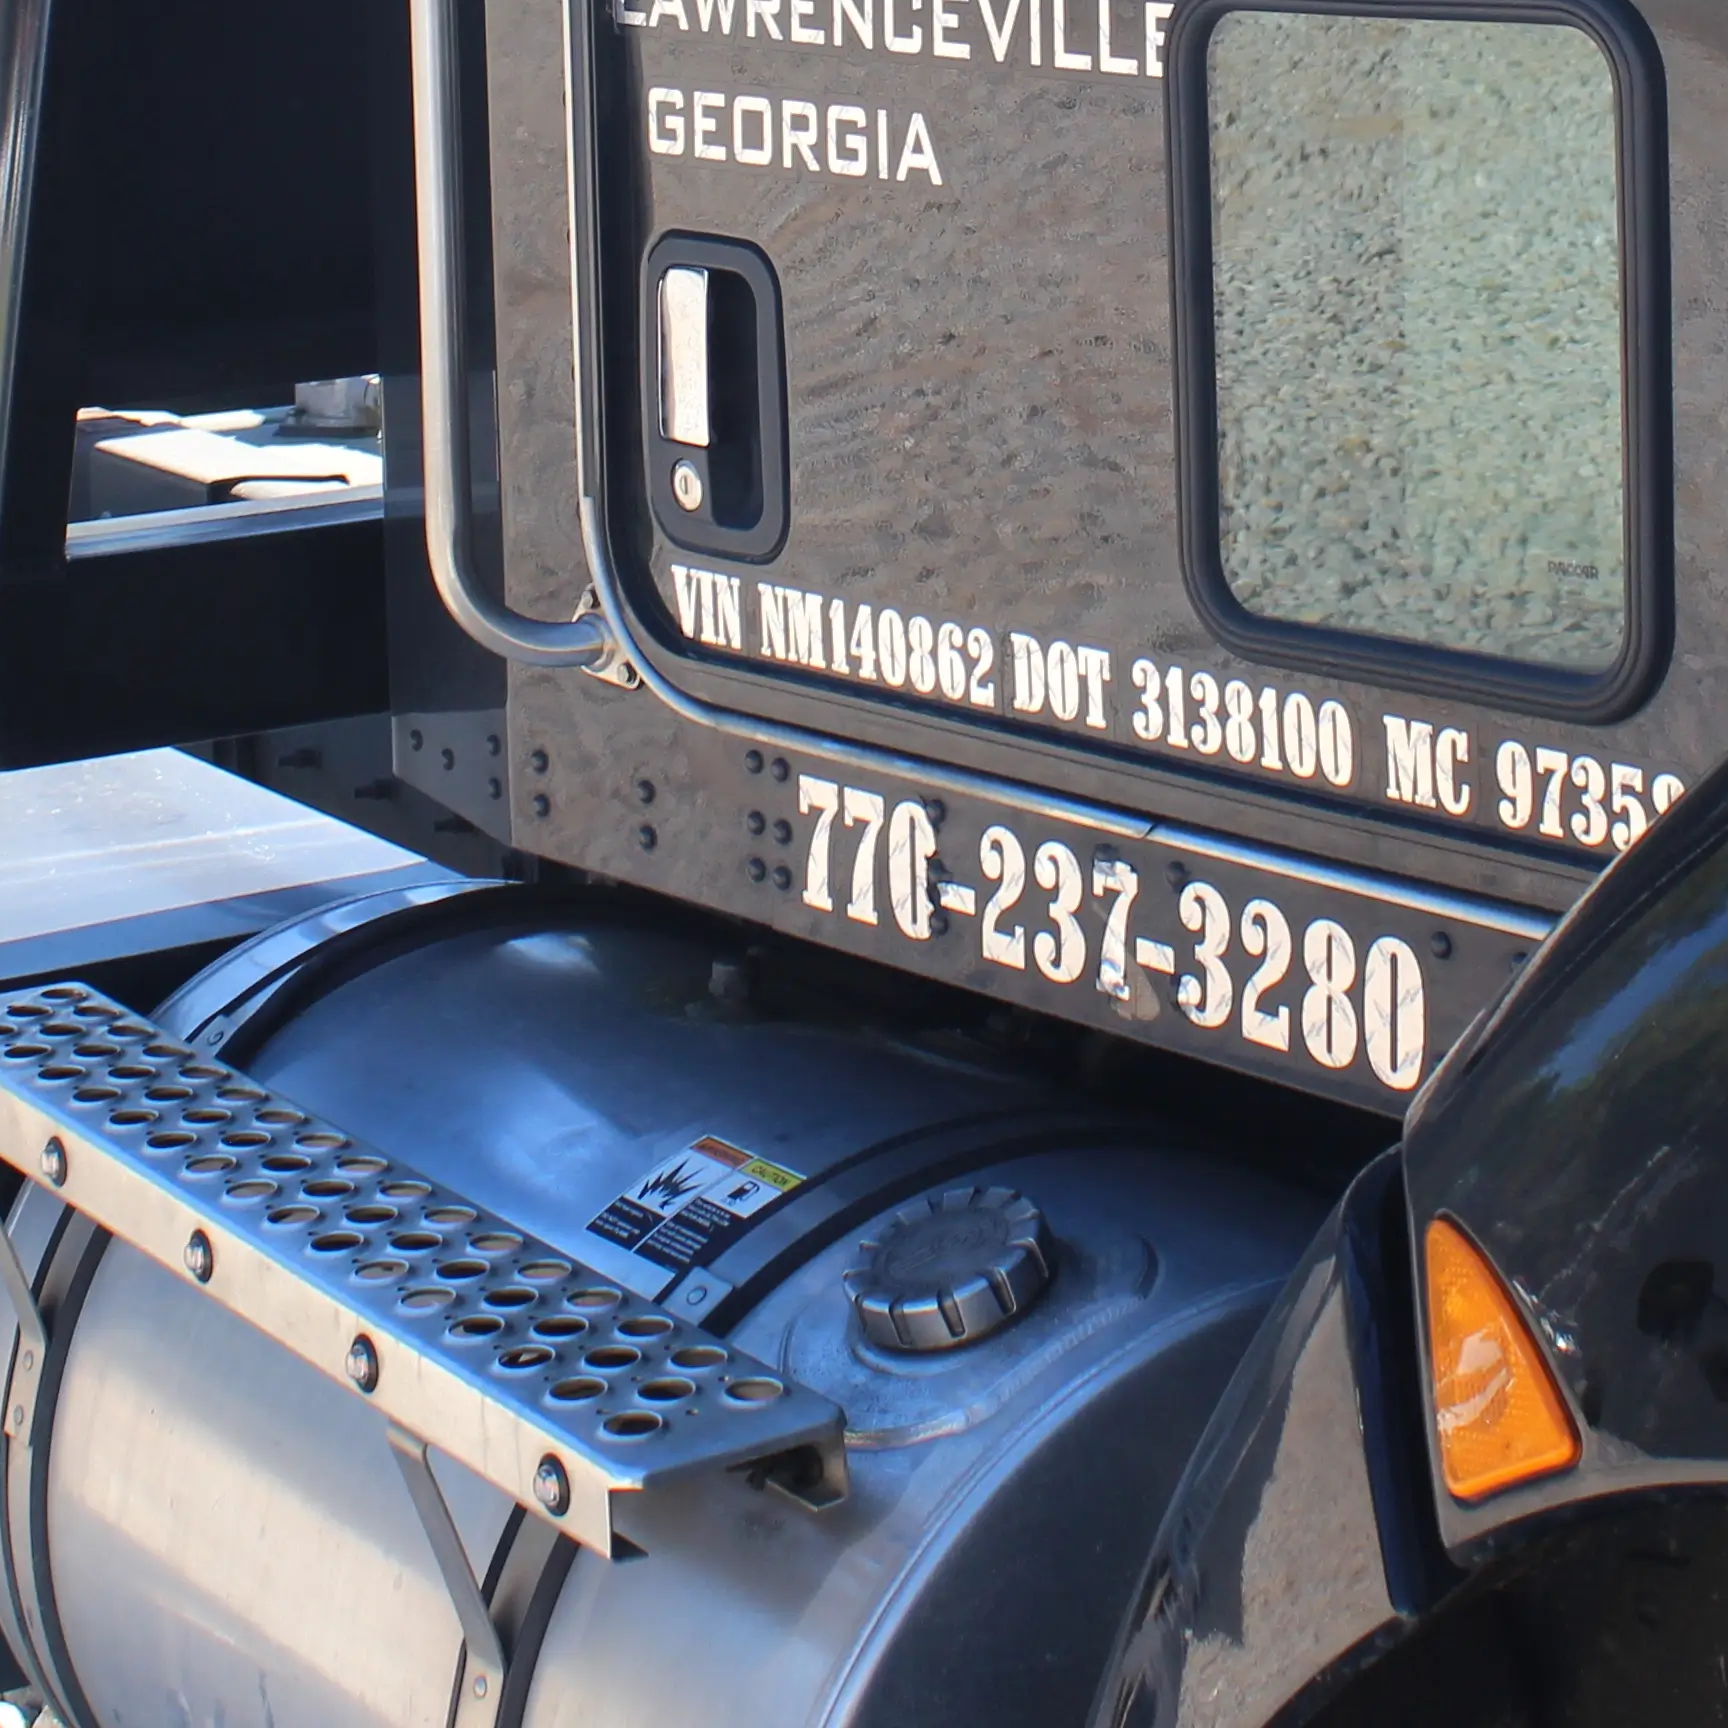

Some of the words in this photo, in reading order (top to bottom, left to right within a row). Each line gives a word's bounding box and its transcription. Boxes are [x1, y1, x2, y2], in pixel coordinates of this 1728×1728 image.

[647, 86, 943, 187] GEORGIA
[671, 565, 743, 651] VIN
[757, 582, 996, 709] NM140862
[1010, 632, 1111, 730] DOT
[1131, 657, 1354, 787] 3138100
[1381, 714, 1471, 816] MC
[797, 773, 1428, 1091] 770-237-3280
